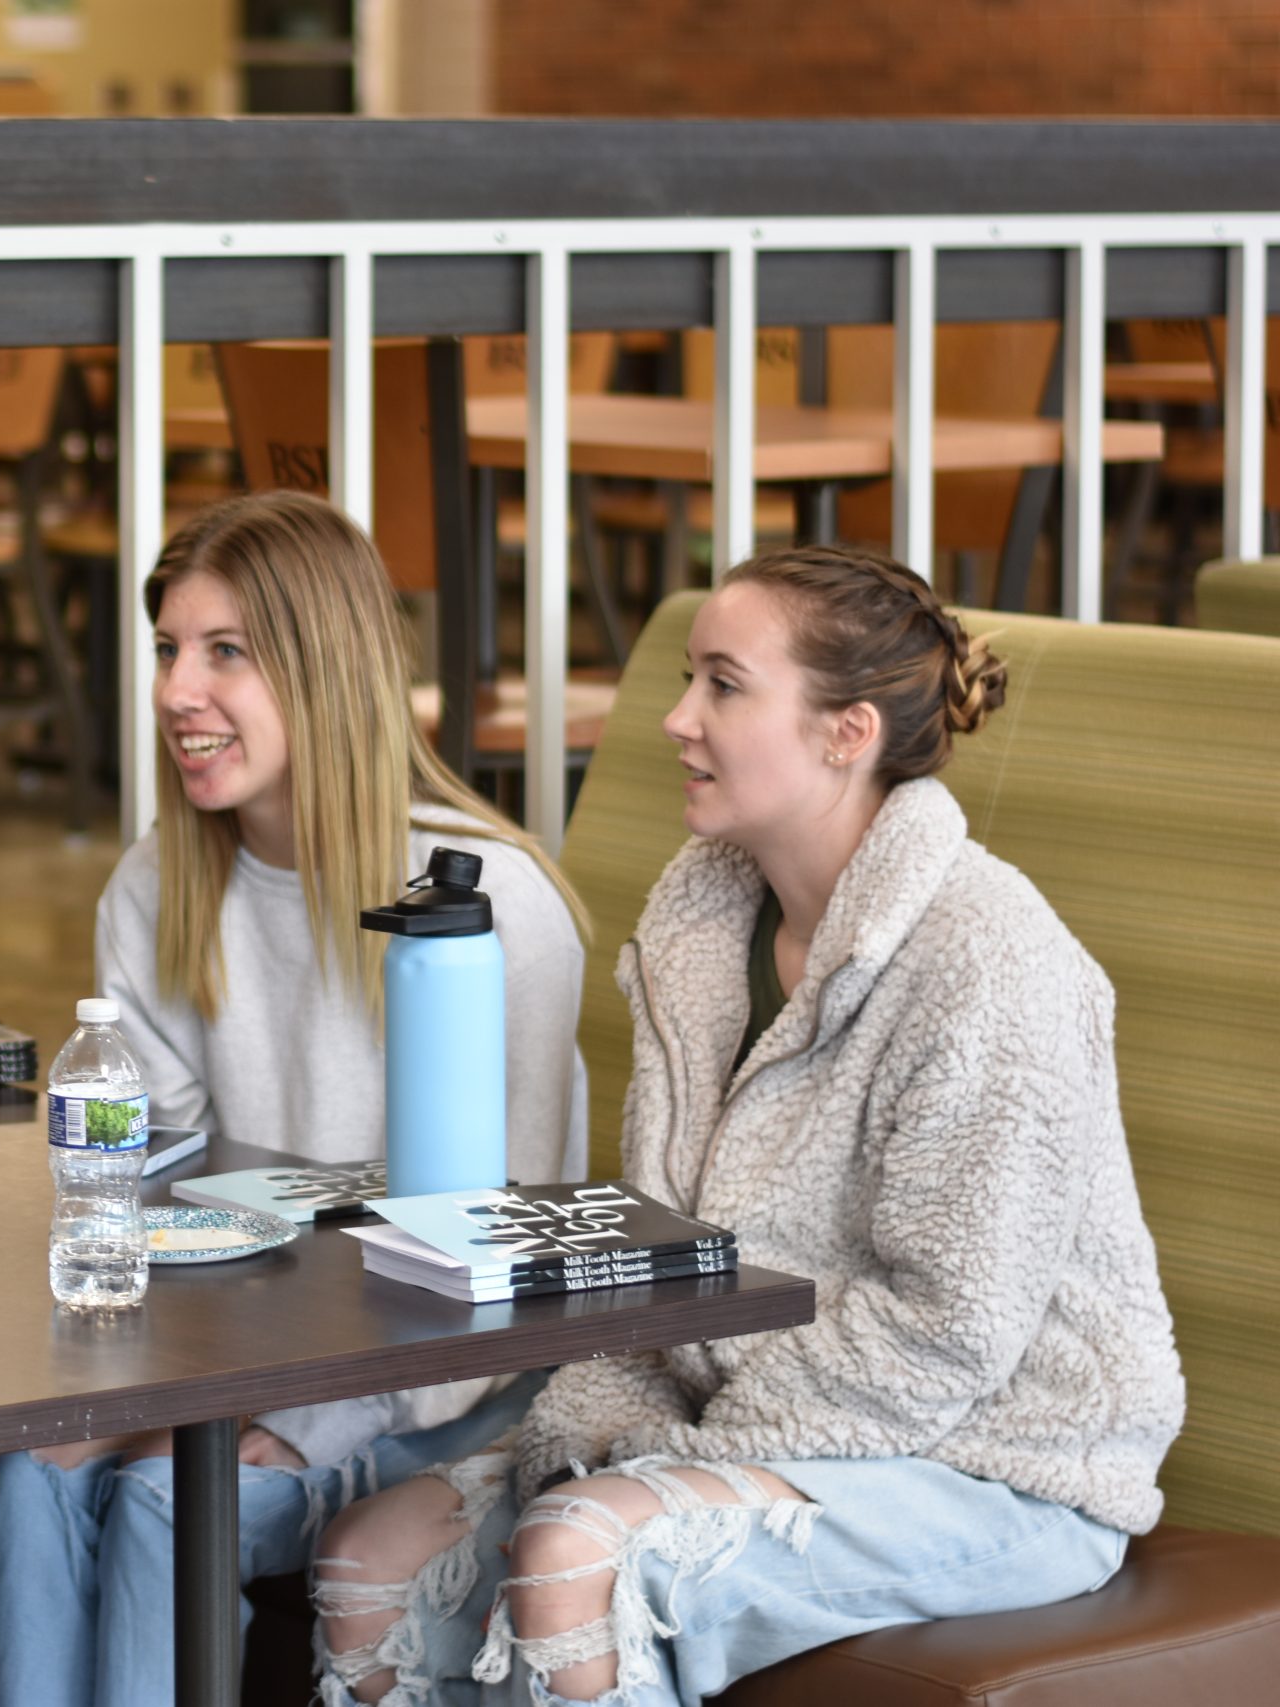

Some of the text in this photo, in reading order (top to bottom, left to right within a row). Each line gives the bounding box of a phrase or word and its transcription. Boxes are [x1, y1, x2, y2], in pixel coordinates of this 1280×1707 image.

[532, 1185, 642, 1251] Tooth
[611, 1248, 652, 1261] Magazine
[695, 1239, 714, 1250] Vol.
[611, 1260, 652, 1273] Magazine
[696, 1251, 715, 1262] Vol.
[613, 1271, 654, 1285] Magazine
[697, 1262, 717, 1273] Vol.
